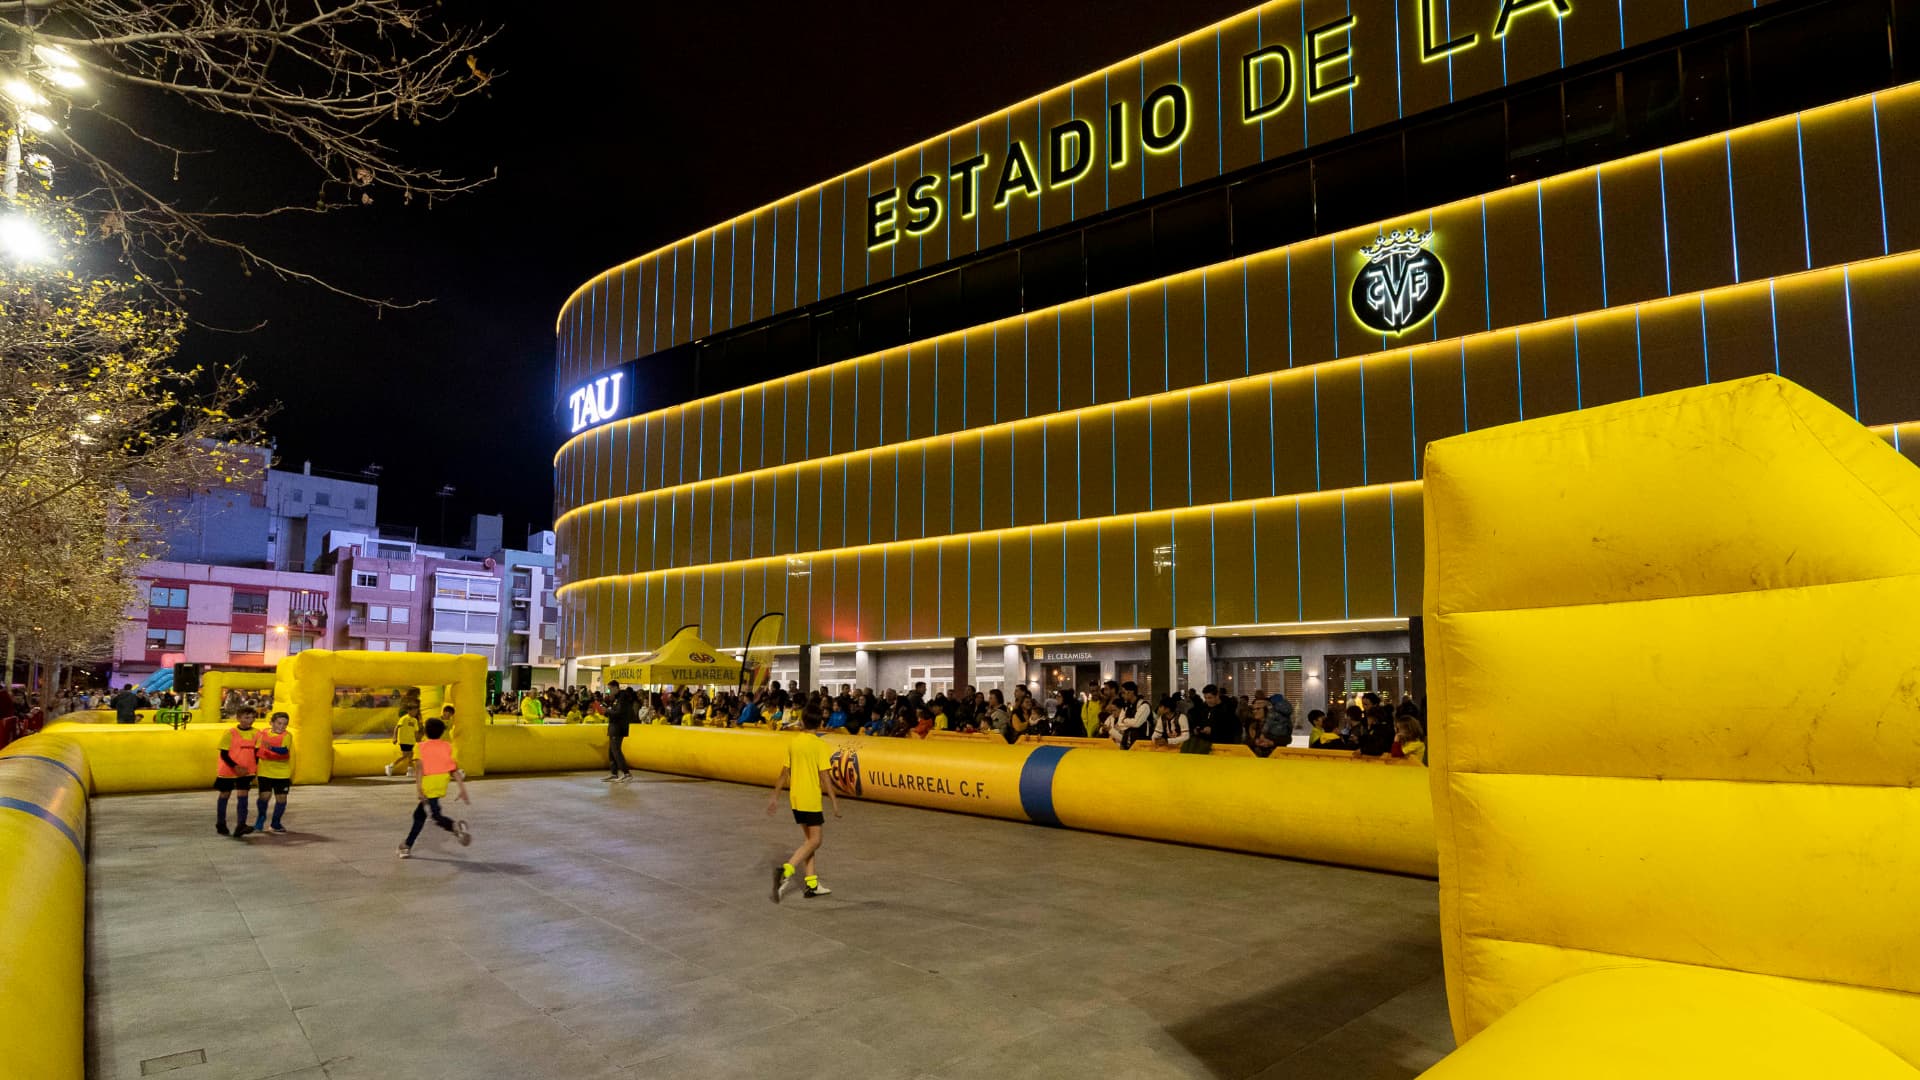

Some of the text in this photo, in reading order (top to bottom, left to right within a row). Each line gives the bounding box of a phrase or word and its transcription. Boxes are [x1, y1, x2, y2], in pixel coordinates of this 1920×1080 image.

[867, 83, 1191, 251] ESTADIO
[1242, 14, 1359, 124] DE
[569, 372, 624, 433] TAU
[1056, 652, 1092, 660] CERAMISTA
[610, 668, 634, 679] VILLARREAL
[672, 668, 737, 681] VILLARREAL
[868, 770, 990, 800] VILLARREAL C.F.
